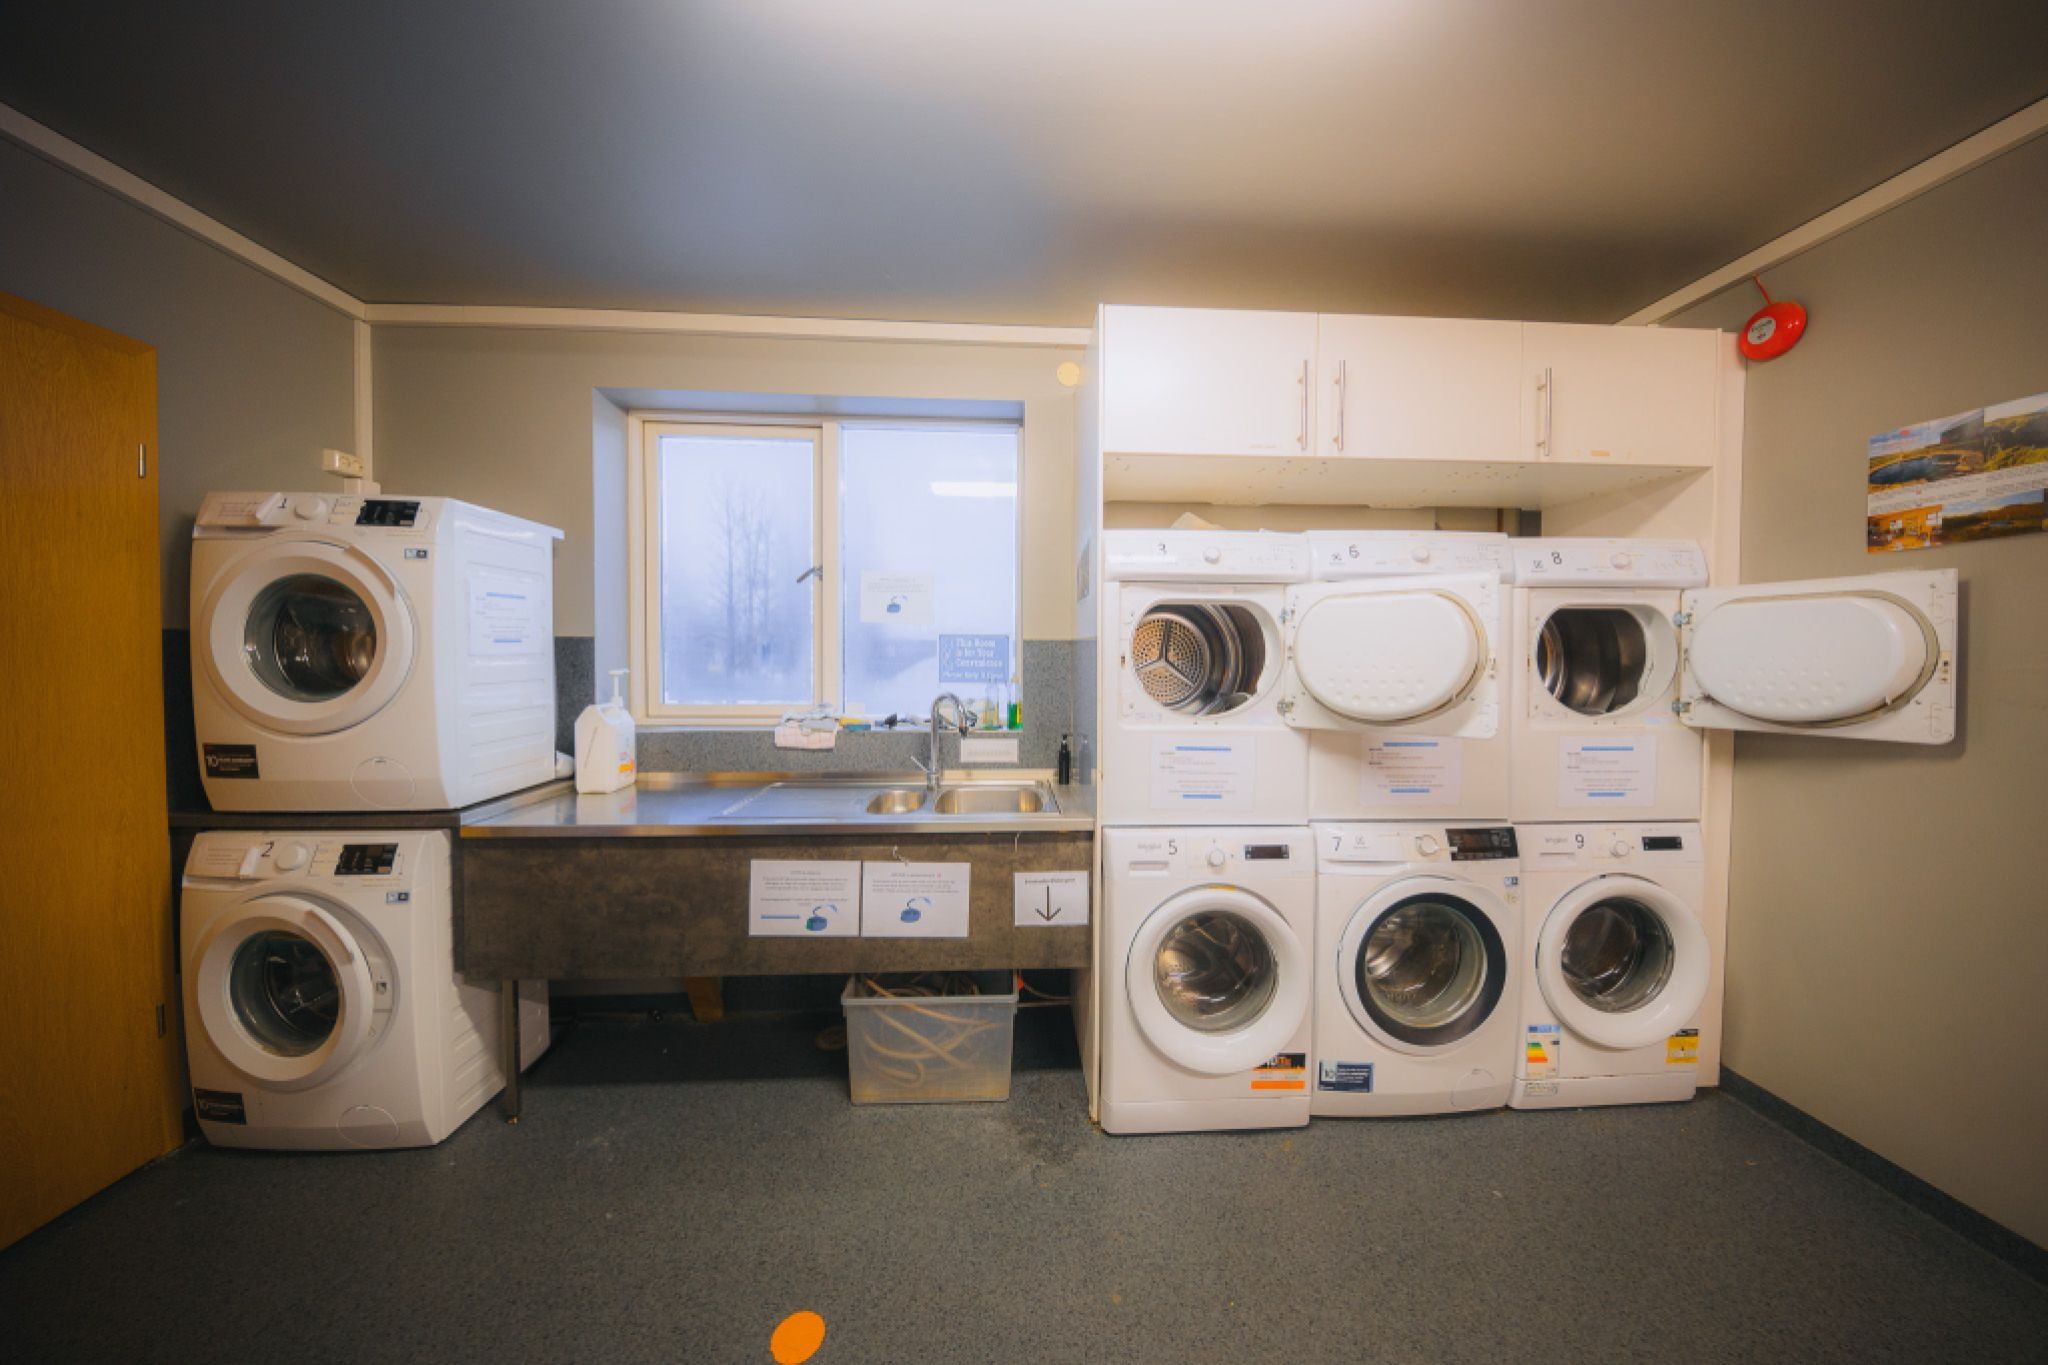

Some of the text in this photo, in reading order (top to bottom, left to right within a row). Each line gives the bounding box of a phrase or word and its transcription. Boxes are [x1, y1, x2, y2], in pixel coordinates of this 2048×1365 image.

[1348, 543, 1361, 559] 6
[1551, 550, 1563, 565] 8
[260, 840, 275, 857] 2
[1168, 838, 1178, 855] 5
[1332, 836, 1342, 851] 7
[1575, 833, 1585, 849] 9
